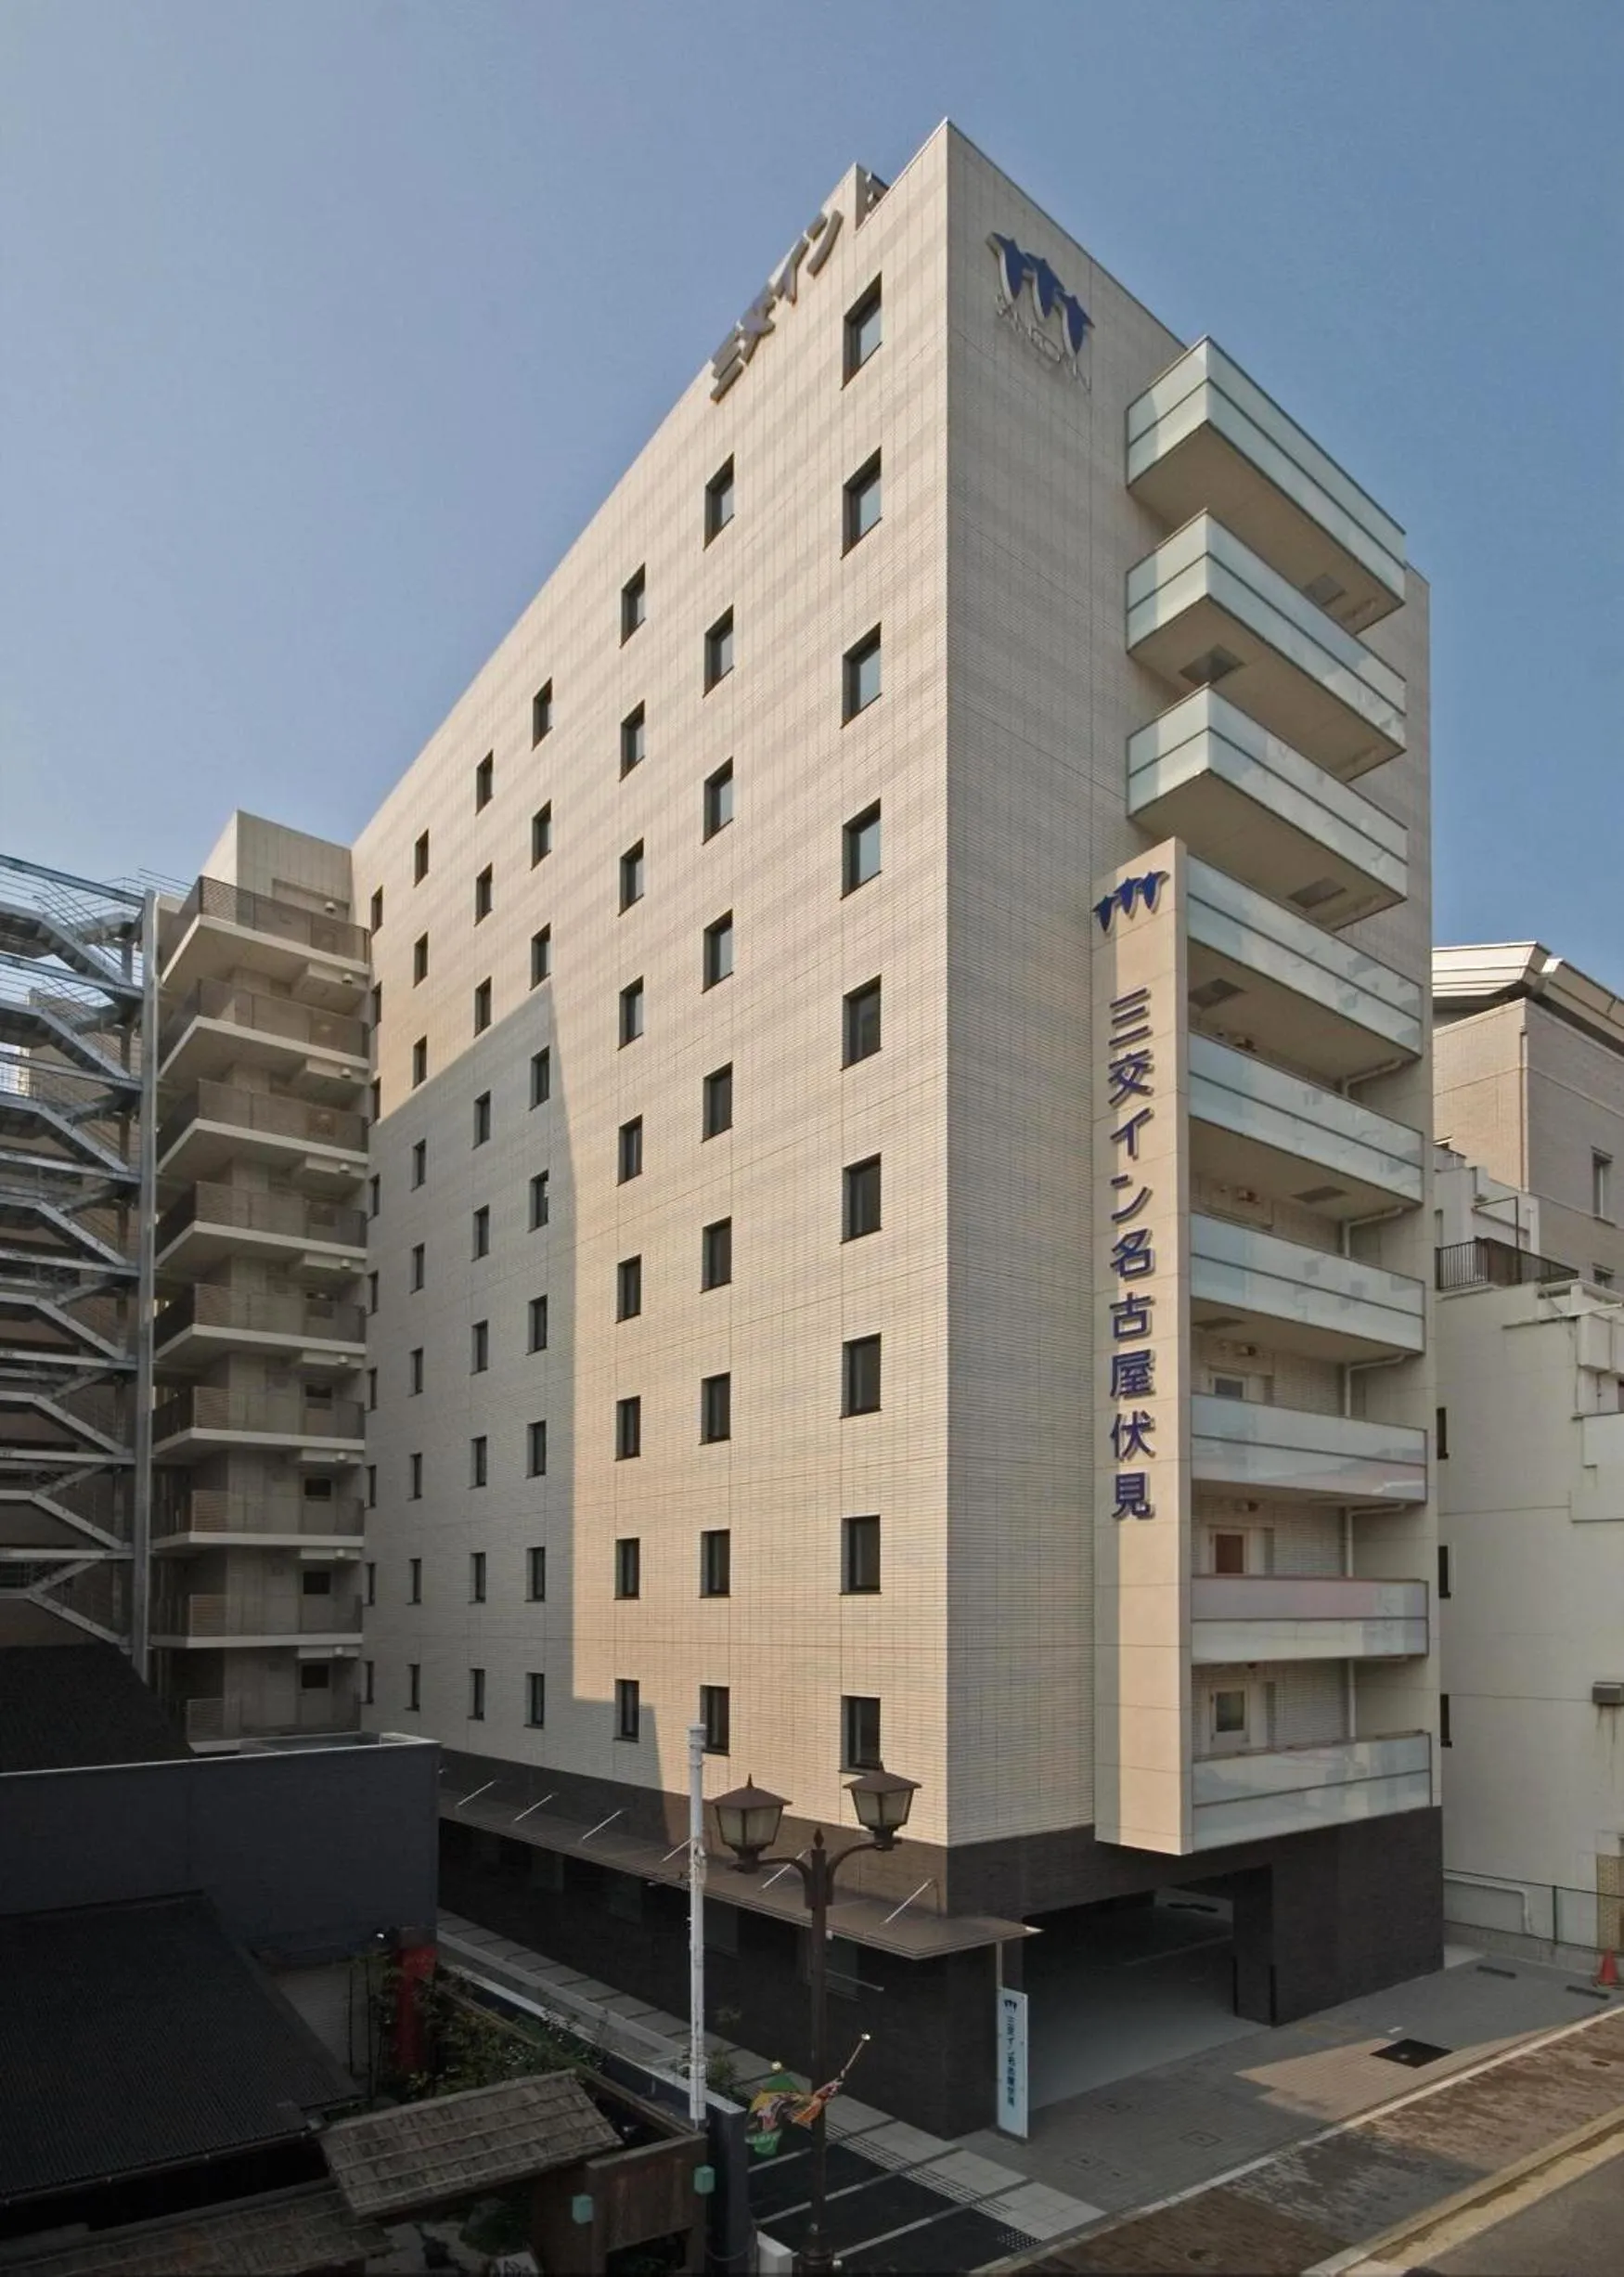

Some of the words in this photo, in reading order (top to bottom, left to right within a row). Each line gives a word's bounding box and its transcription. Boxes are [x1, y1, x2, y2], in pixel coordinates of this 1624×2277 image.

[1108, 987, 1154, 1520] 三交イン名古屋伏見
